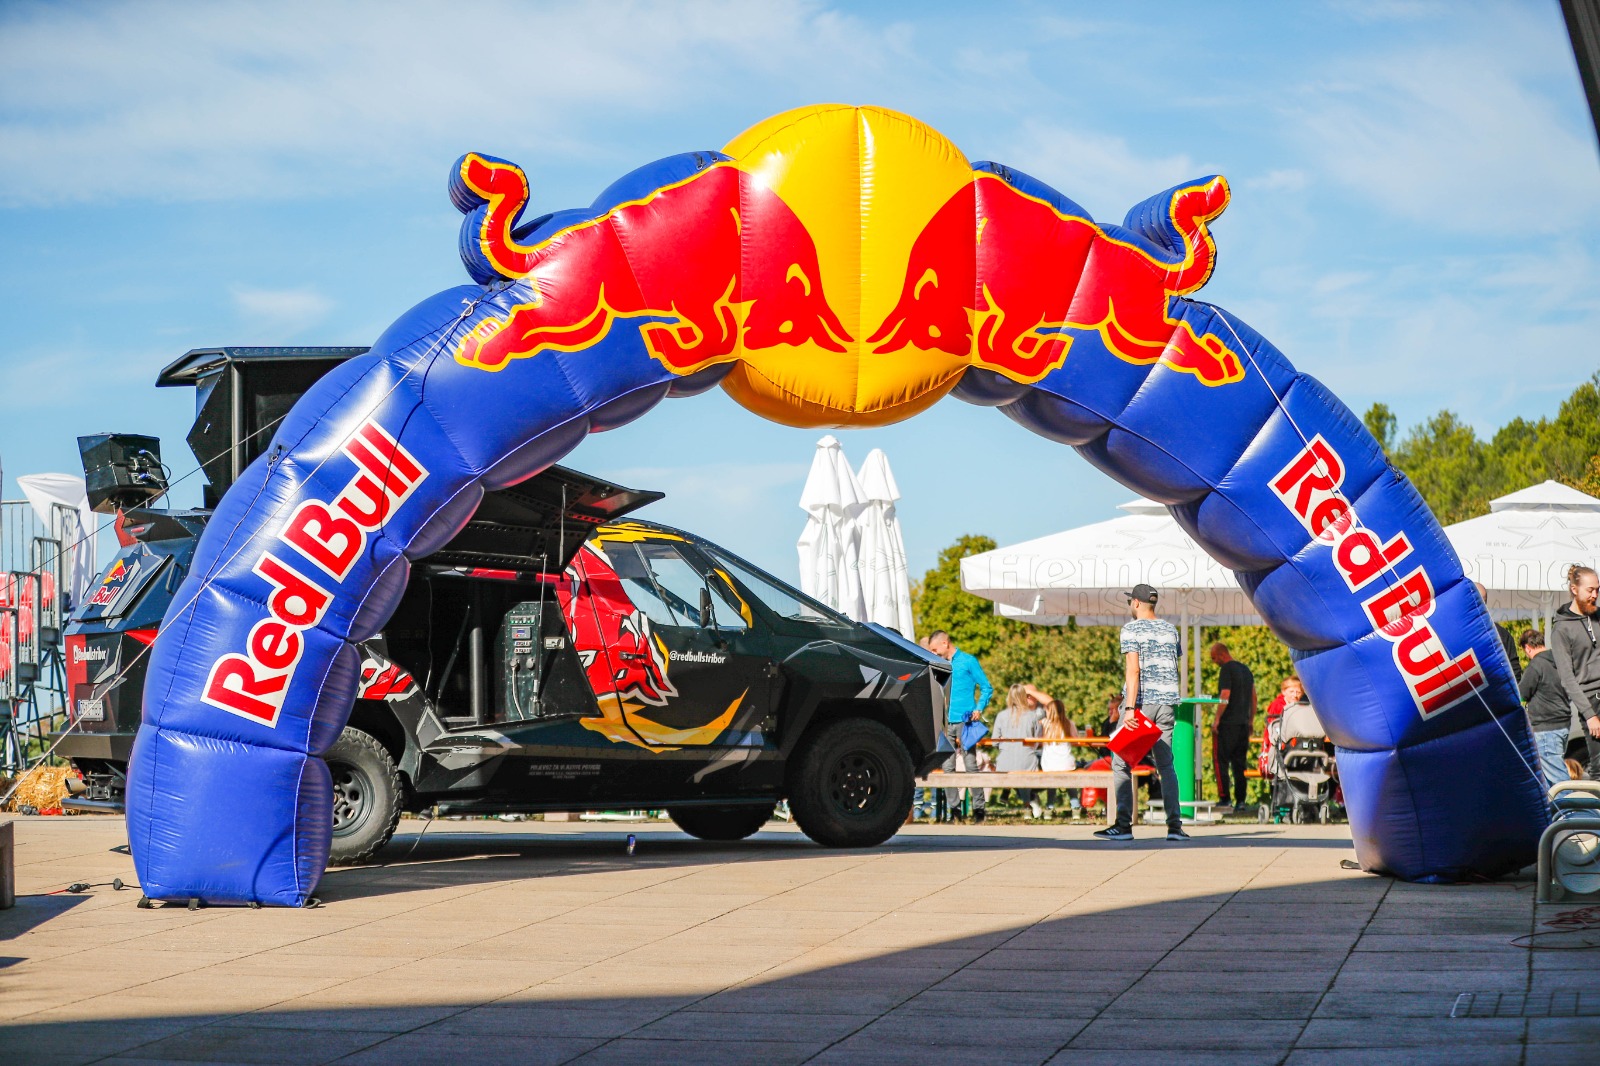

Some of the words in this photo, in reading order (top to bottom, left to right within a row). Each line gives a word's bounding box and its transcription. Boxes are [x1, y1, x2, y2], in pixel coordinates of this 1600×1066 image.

[202, 551, 334, 727] Red
[279, 419, 428, 582] Bull
[669, 650, 726, 664] @redbullstribor
[1269, 435, 1412, 592] Red
[1362, 567, 1488, 719] Bull
